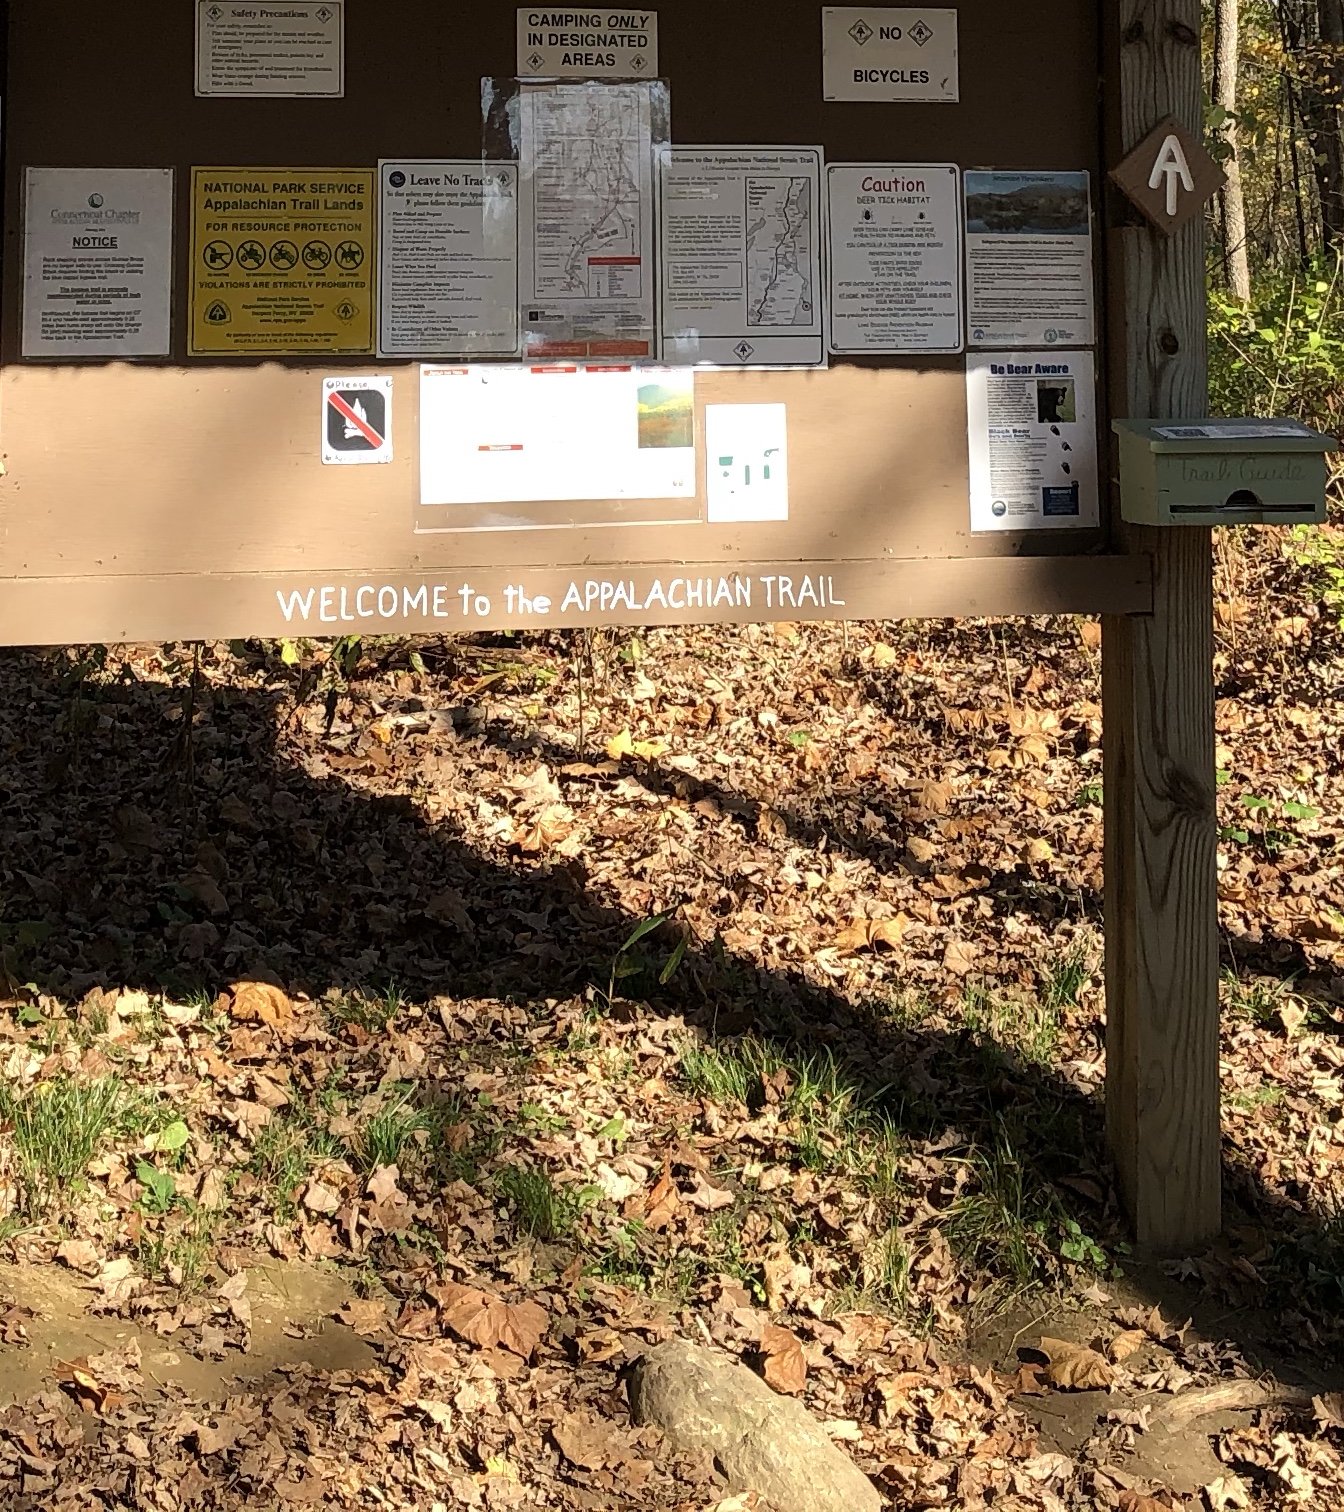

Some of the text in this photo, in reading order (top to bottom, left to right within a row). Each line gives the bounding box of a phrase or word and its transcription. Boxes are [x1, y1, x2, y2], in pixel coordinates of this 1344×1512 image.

[231, 9, 308, 20] Safety Precautions
[528, 13, 650, 30] CAMPING ONLY
[879, 26, 902, 40] NO
[528, 32, 649, 48] IN DESIGNATED
[561, 53, 616, 66] AREAS
[853, 69, 929, 84] BICYCLES
[714, 157, 752, 165] Appalachian
[410, 174, 441, 186] Leave
[443, 174, 460, 186] No
[861, 176, 925, 193] Caution
[203, 182, 365, 194] NATIONAL PARK SERVICE
[203, 198, 364, 212] Appalachian Trail Lands
[857, 196, 931, 204] DEER TICK HABITAT
[205, 222, 362, 232] FOR RESOURCE PROTECTION
[72, 236, 118, 248] NOTICE
[199, 281, 250, 289] VIOLATIONS
[316, 281, 366, 289] PROHIBITED
[990, 364, 1069, 375] Be Bear Aware
[1172, 457, 1307, 483] Trail Guide
[276, 574, 846, 622] WELCOME to the APPALACHIAN TRAIL
